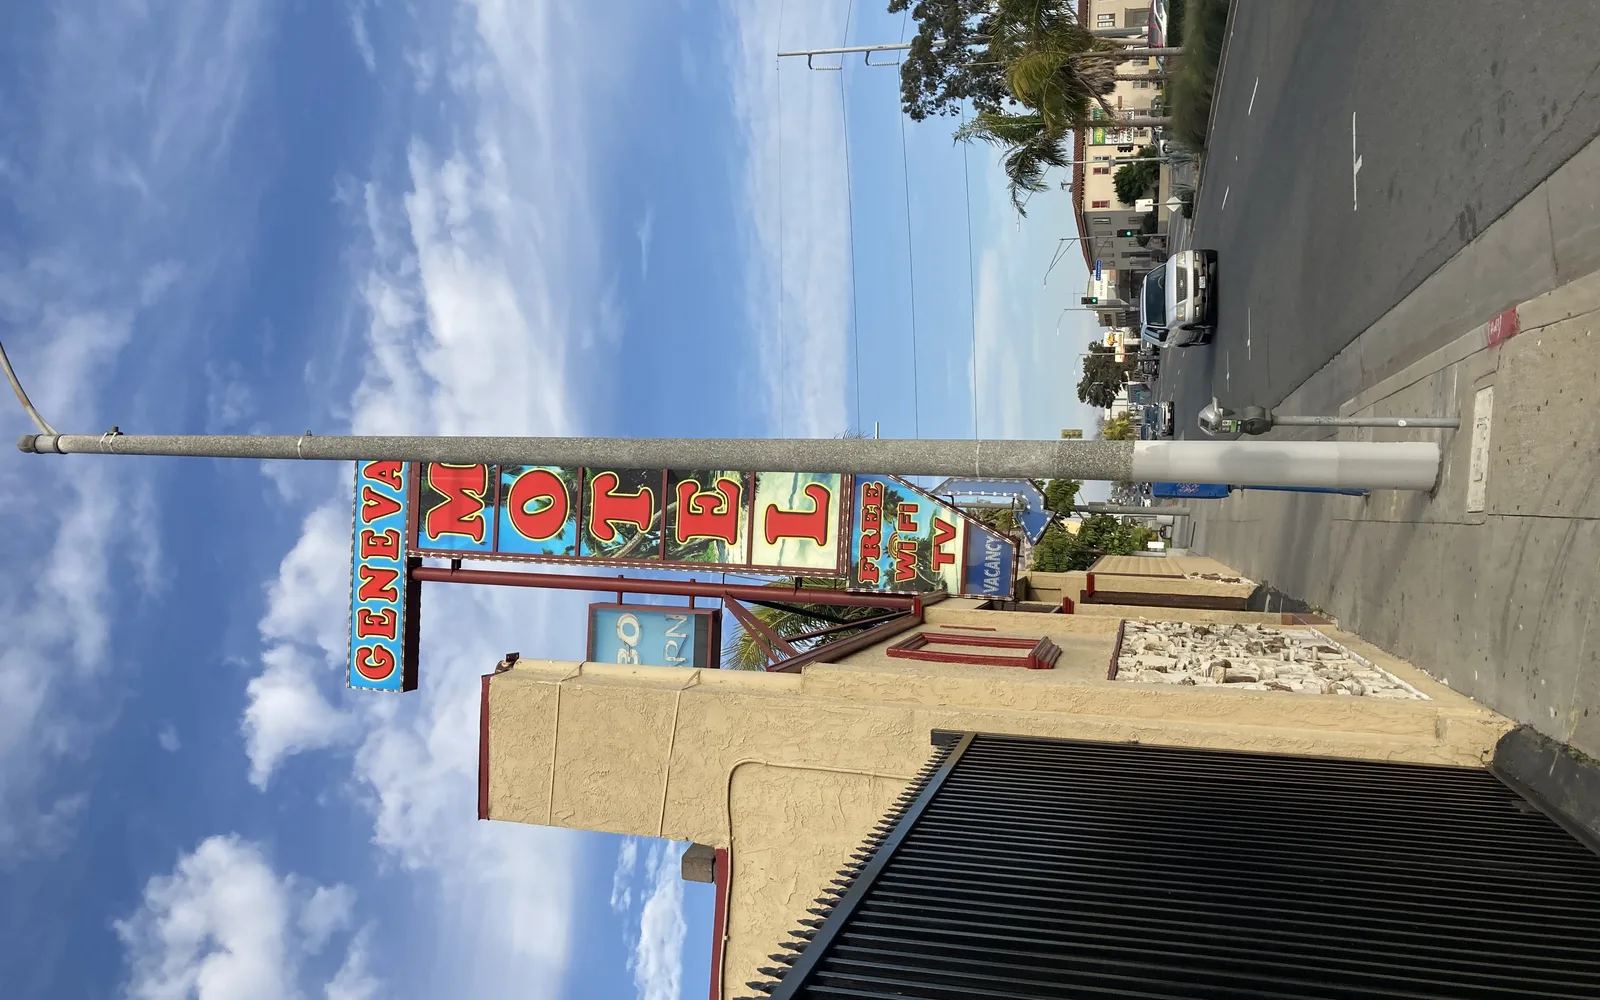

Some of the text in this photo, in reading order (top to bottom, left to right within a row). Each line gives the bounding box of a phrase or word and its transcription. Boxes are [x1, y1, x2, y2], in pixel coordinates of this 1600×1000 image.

[426, 462, 831, 546] MOTEL
[858, 481, 884, 583] FREE
[895, 502, 919, 582] Wi Fi
[931, 516, 957, 572] TV
[354, 460, 405, 680] GENEVA
[982, 535, 1003, 595] VACANCY
[617, 613, 641, 664] BO
